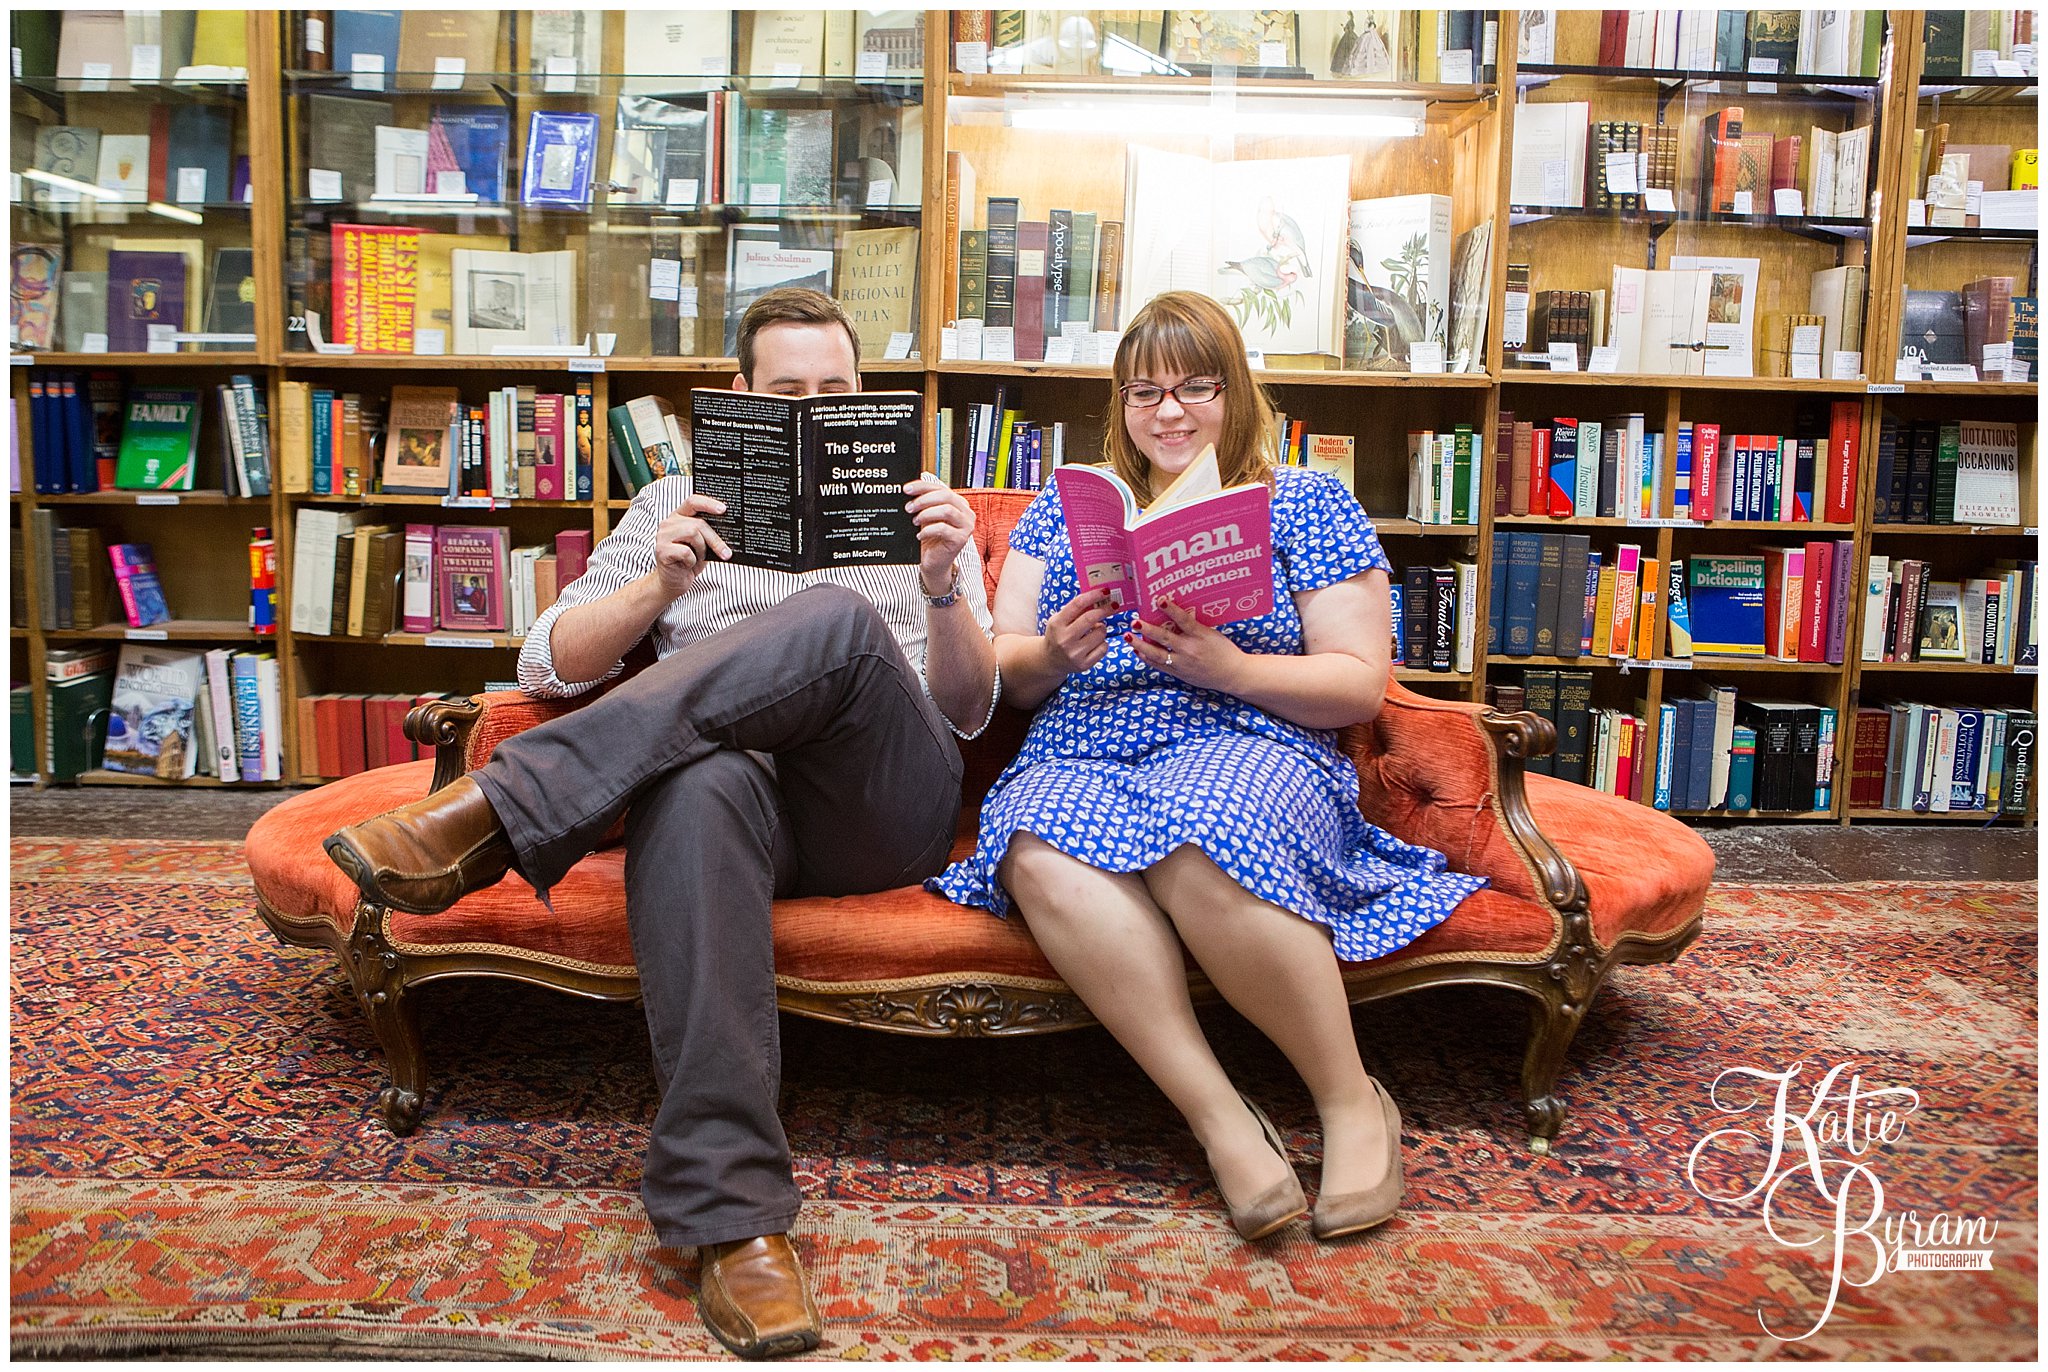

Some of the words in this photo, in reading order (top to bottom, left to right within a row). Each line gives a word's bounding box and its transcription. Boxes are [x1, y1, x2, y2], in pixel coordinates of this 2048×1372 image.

[947, 178, 957, 228] EUROPE
[344, 231, 359, 272] KOPP
[744, 252, 770, 263] Julius
[772, 253, 812, 263] Shulman
[856, 242, 902, 257] CLYDE
[1051, 221, 1069, 291] Apocalypse
[851, 264, 902, 279] VALLEY
[1104, 254, 1114, 272] from
[360, 232, 378, 351] CONSTRUCTIVIST
[377, 233, 396, 351] ARCHITECTURE
[843, 286, 907, 301] REGIONAL
[1101, 288, 1111, 313] Austen
[854, 309, 891, 322] PLAN
[2020, 301, 2035, 312] The
[288, 316, 306, 332] 22
[396, 306, 414, 334] THE
[396, 336, 413, 352] IN
[1868, 385, 1904, 393] Reference
[130, 403, 191, 423] FAMILY
[815, 405, 838, 413] serious,
[838, 404, 878, 412] all-revealing,
[879, 404, 914, 412] compelling
[823, 412, 857, 420] remarkably
[885, 411, 904, 419] guide
[711, 419, 726, 427] Secret
[732, 421, 754, 429] Success
[765, 424, 783, 433] Women
[824, 420, 859, 428] succeeding
[1555, 427, 1577, 438] Roget's
[1318, 437, 1344, 446] Modern
[1958, 427, 2016, 448] UOTATIONS
[824, 442, 850, 455] The
[852, 441, 896, 454] Secret
[1313, 445, 1349, 455] Linguistics
[1843, 440, 1851, 459] Large
[855, 455, 864, 464] of
[1736, 452, 1746, 478] SPELLING
[1752, 452, 1763, 478] SPELLING
[1842, 459, 1850, 476] Print
[1958, 451, 2014, 471] OCCASIONS
[832, 467, 888, 479] Success
[1701, 443, 1714, 497] Thesaurus
[1766, 457, 1776, 486] IDIOMS
[819, 483, 848, 497] With
[851, 482, 902, 494] Women
[1734, 478, 1745, 512] DICTIONARY
[1751, 478, 1761, 512] DICTIONARY
[1839, 476, 1849, 510] Dictionary
[1959, 504, 2016, 513] ELIZABETH
[1964, 511, 2012, 519] KNOWLES
[442, 546, 493, 554] COMPANION
[447, 538, 487, 546] READER'S
[1143, 523, 1244, 579] man
[443, 558, 494, 567] TWENTIETH
[833, 551, 851, 559] Sean
[852, 550, 887, 558] McCarthy
[1816, 548, 1825, 580] Chambers
[1842, 548, 1850, 560] The
[1147, 543, 1263, 596] management
[1710, 560, 1762, 575] Spelling
[1177, 566, 1252, 597] women
[1696, 573, 1763, 589] Dictionary
[1814, 580, 1823, 599] Large
[1838, 579, 1848, 595] Large
[1615, 574, 1627, 629] DICTIONARY
[1668, 572, 1687, 613] Roget's
[1905, 584, 1914, 610] RELEVANT
[1910, 586, 1919, 619] MACMILLAN
[1785, 580, 1795, 632] DICTIONARY
[1814, 599, 1822, 615] Print
[1436, 586, 1456, 648] Fowler's
[1835, 610, 1845, 640] Dictionary
[1901, 610, 1911, 644] QUOTATIONS
[1984, 603, 1998, 648] QUOTATIONS
[1810, 616, 1821, 648] Dictionary
[245, 677, 260, 757] GUINNESS
[1826, 722, 1834, 742] OXFORD
[1939, 728, 1950, 756] QUOTATIONS
[1826, 743, 1834, 758] 20th
[1954, 713, 1978, 781] QUOTATIONS
[1967, 737, 1975, 752] Oxford
[1816, 743, 1828, 782] Quotations
[1824, 757, 1833, 782] Century
[1963, 752, 1973, 774] Dictionary
[2011, 729, 2034, 803] Quotations
